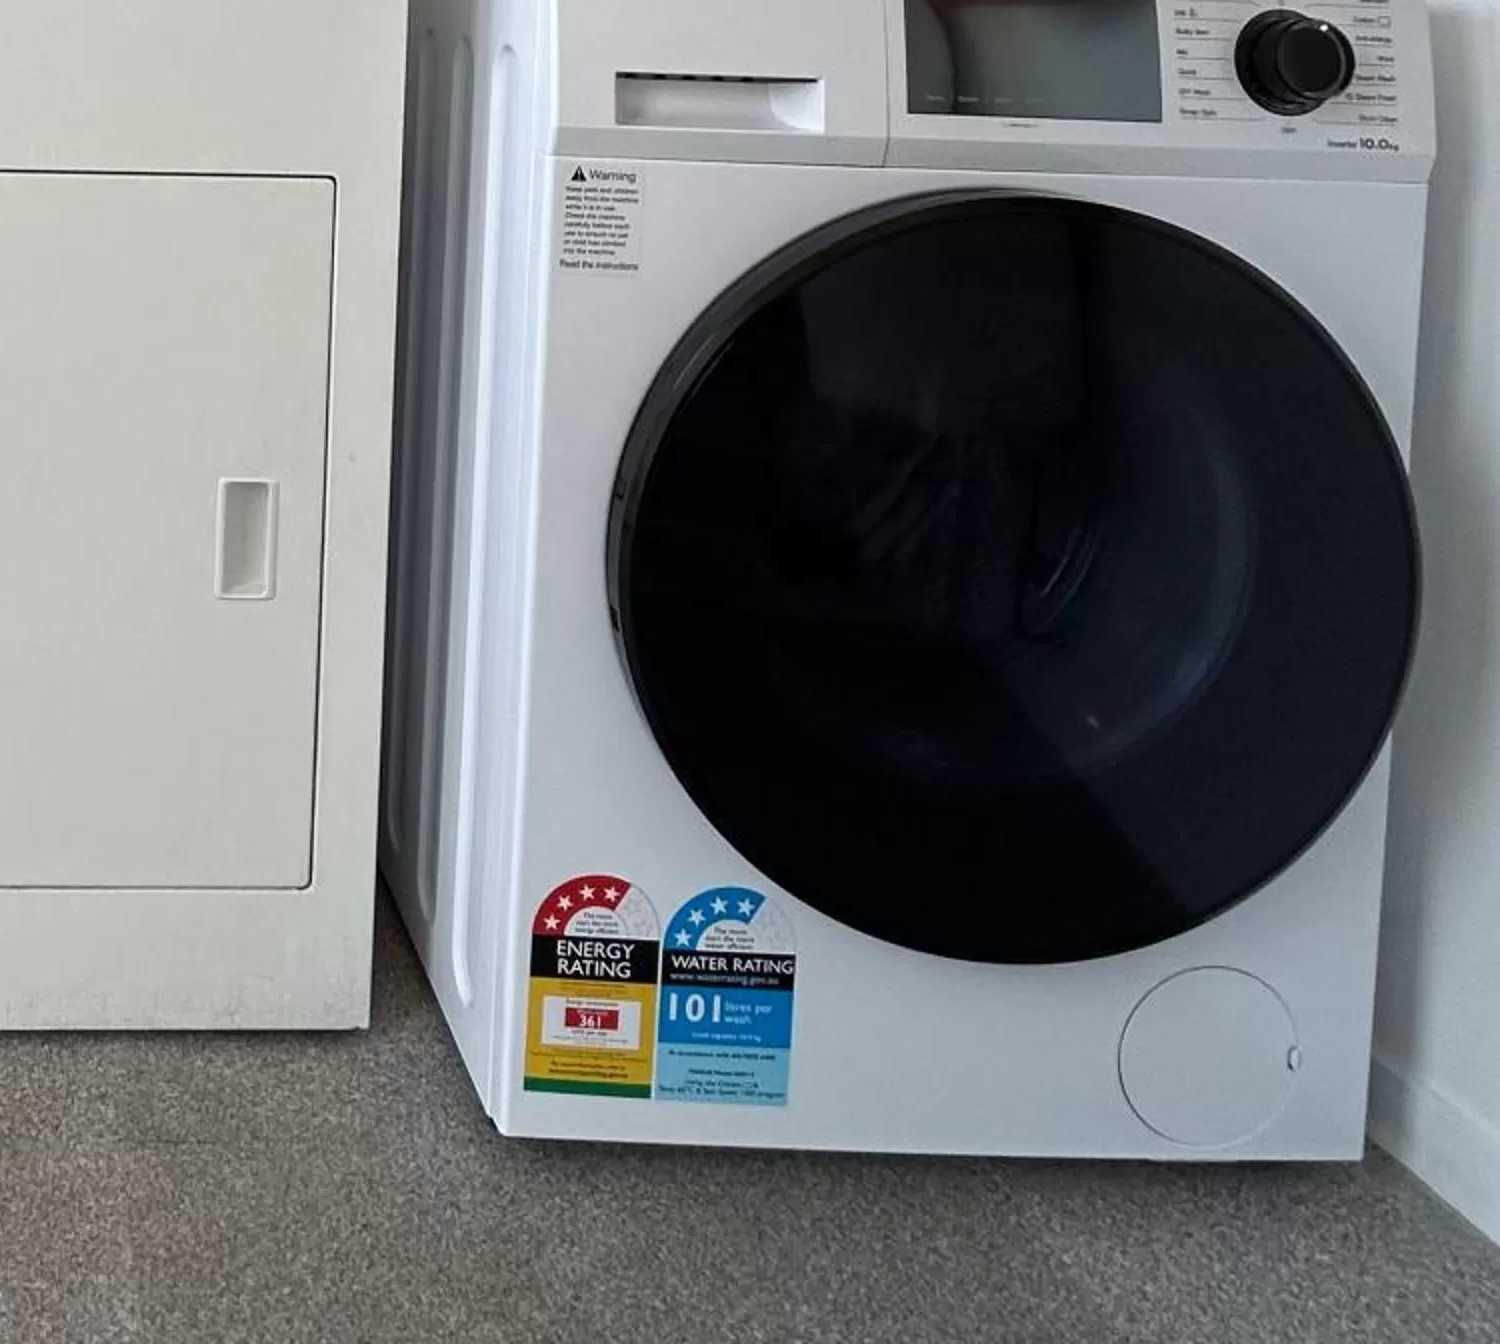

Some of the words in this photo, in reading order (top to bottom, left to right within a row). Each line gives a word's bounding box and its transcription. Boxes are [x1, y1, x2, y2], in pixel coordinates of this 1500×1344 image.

[589, 168, 637, 184] Warning
[560, 258, 581, 268] Read
[582, 260, 594, 269] the
[556, 940, 635, 961] ENERGY
[557, 959, 632, 979] RATING
[671, 955, 728, 972] WATER
[732, 958, 795, 975] RATING
[668, 991, 721, 1023] 101
[579, 1014, 602, 1029] 361
